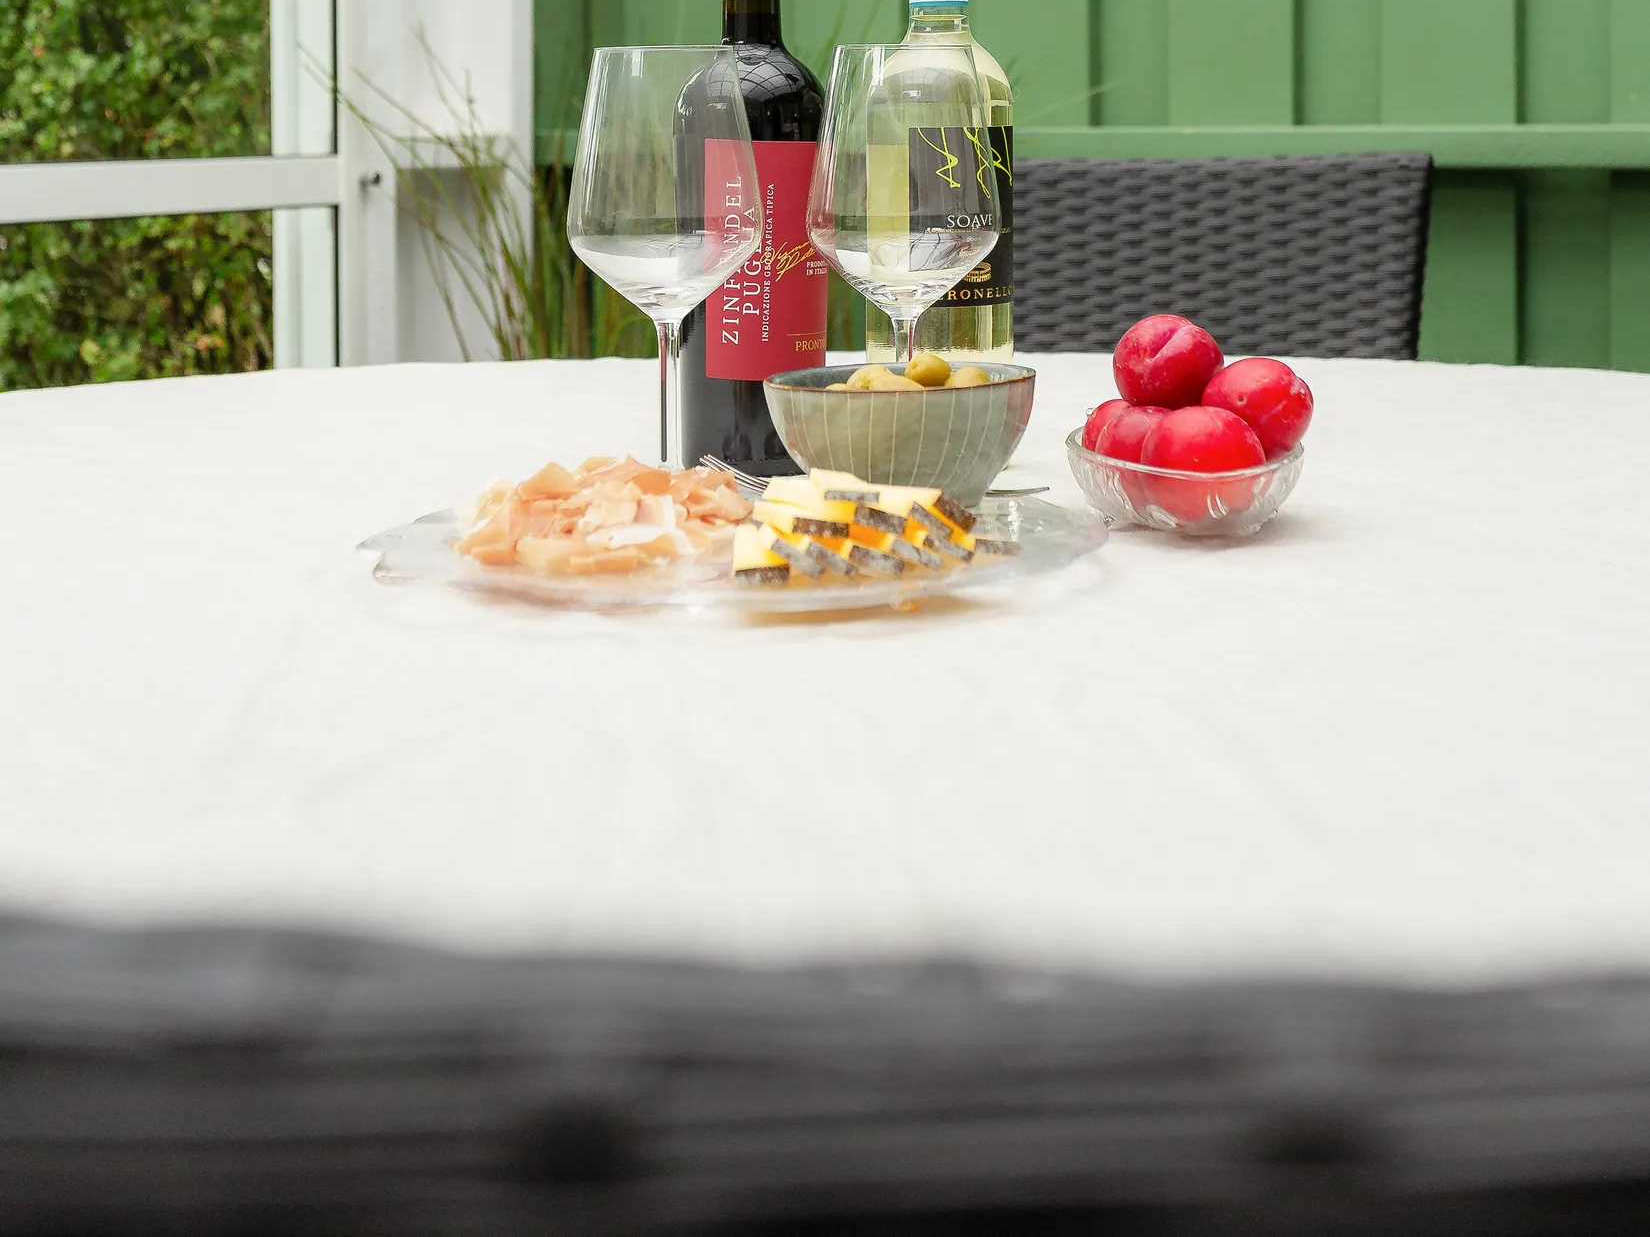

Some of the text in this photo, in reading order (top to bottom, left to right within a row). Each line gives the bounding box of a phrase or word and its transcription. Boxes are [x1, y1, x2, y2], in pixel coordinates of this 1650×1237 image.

[947, 214, 993, 229] SOAVE
[761, 183, 775, 342] INDICAZIONE GEOGRAFICA TIPICA
[937, 285, 1013, 301] RONELLO
[795, 337, 827, 352] PRONT
